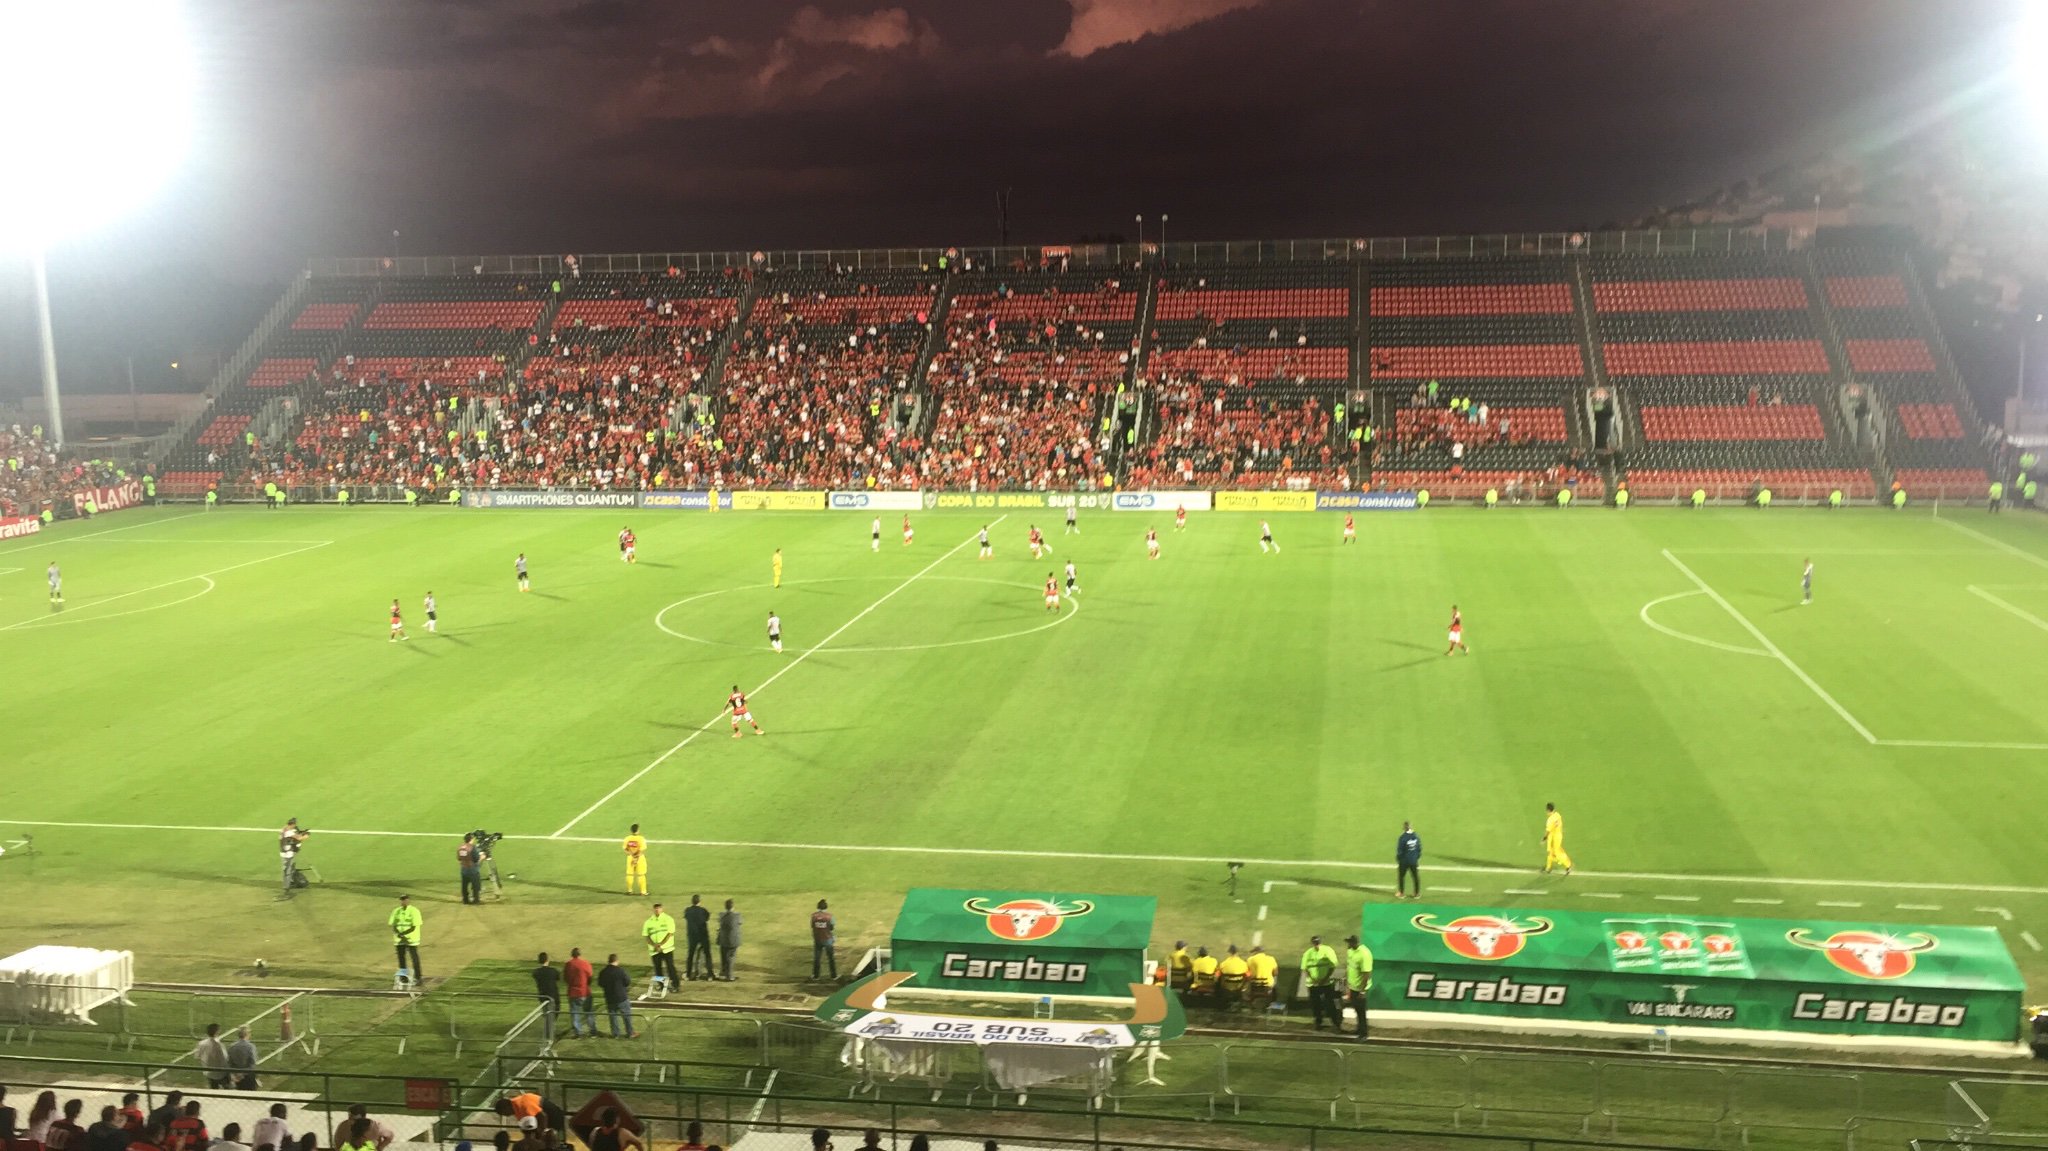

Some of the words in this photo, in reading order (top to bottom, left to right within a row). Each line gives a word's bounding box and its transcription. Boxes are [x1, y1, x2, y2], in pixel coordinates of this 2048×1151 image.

[496, 494, 574, 505] SMARTPHONES
[575, 494, 635, 505] QUANTUM
[835, 495, 867, 506] EMS
[938, 495, 973, 507] COPA
[976, 496, 995, 507] DO
[998, 495, 1044, 507] BRASIL
[1079, 495, 1097, 507] 20
[1118, 494, 1153, 506] EMS
[942, 953, 1088, 982] Carabao
[1407, 973, 1567, 1005] Carabao
[1628, 1002, 1652, 1015] VAI
[1655, 1004, 1734, 1019] ENCARAR?
[1793, 993, 1966, 1026] Carabao
[933, 1022, 974, 1032] 20
[986, 1024, 1049, 1036] SUB
[911, 1031, 974, 1040] BRASIL
[982, 1033, 1009, 1041] DO
[1016, 1035, 1066, 1043] COPA
